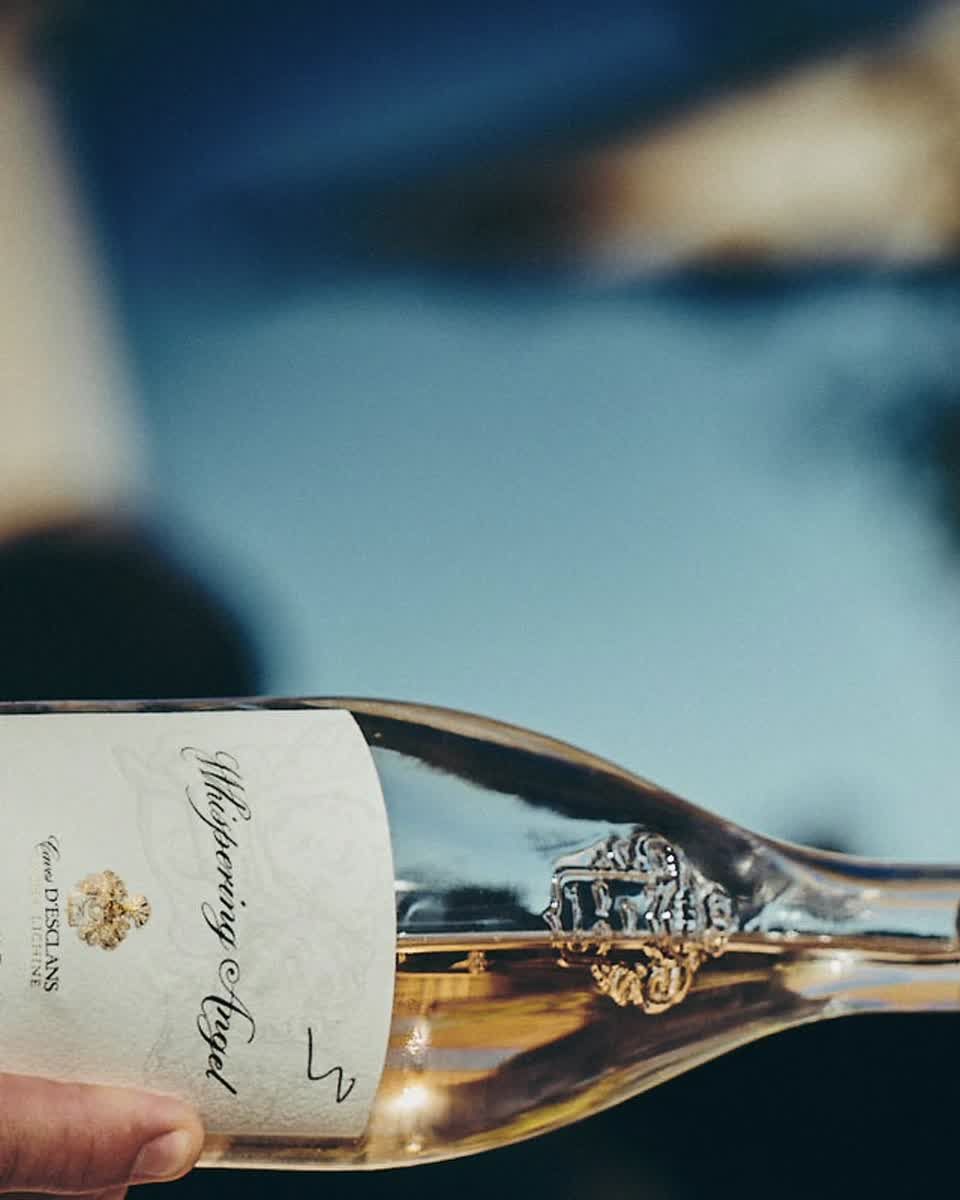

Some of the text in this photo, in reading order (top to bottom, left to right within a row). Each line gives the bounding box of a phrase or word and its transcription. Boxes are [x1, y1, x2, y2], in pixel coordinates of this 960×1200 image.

[35, 835, 62, 883] Caves
[43, 889, 61, 993] D'ESCLANS
[181, 746, 256, 1095] Whispering Angel
